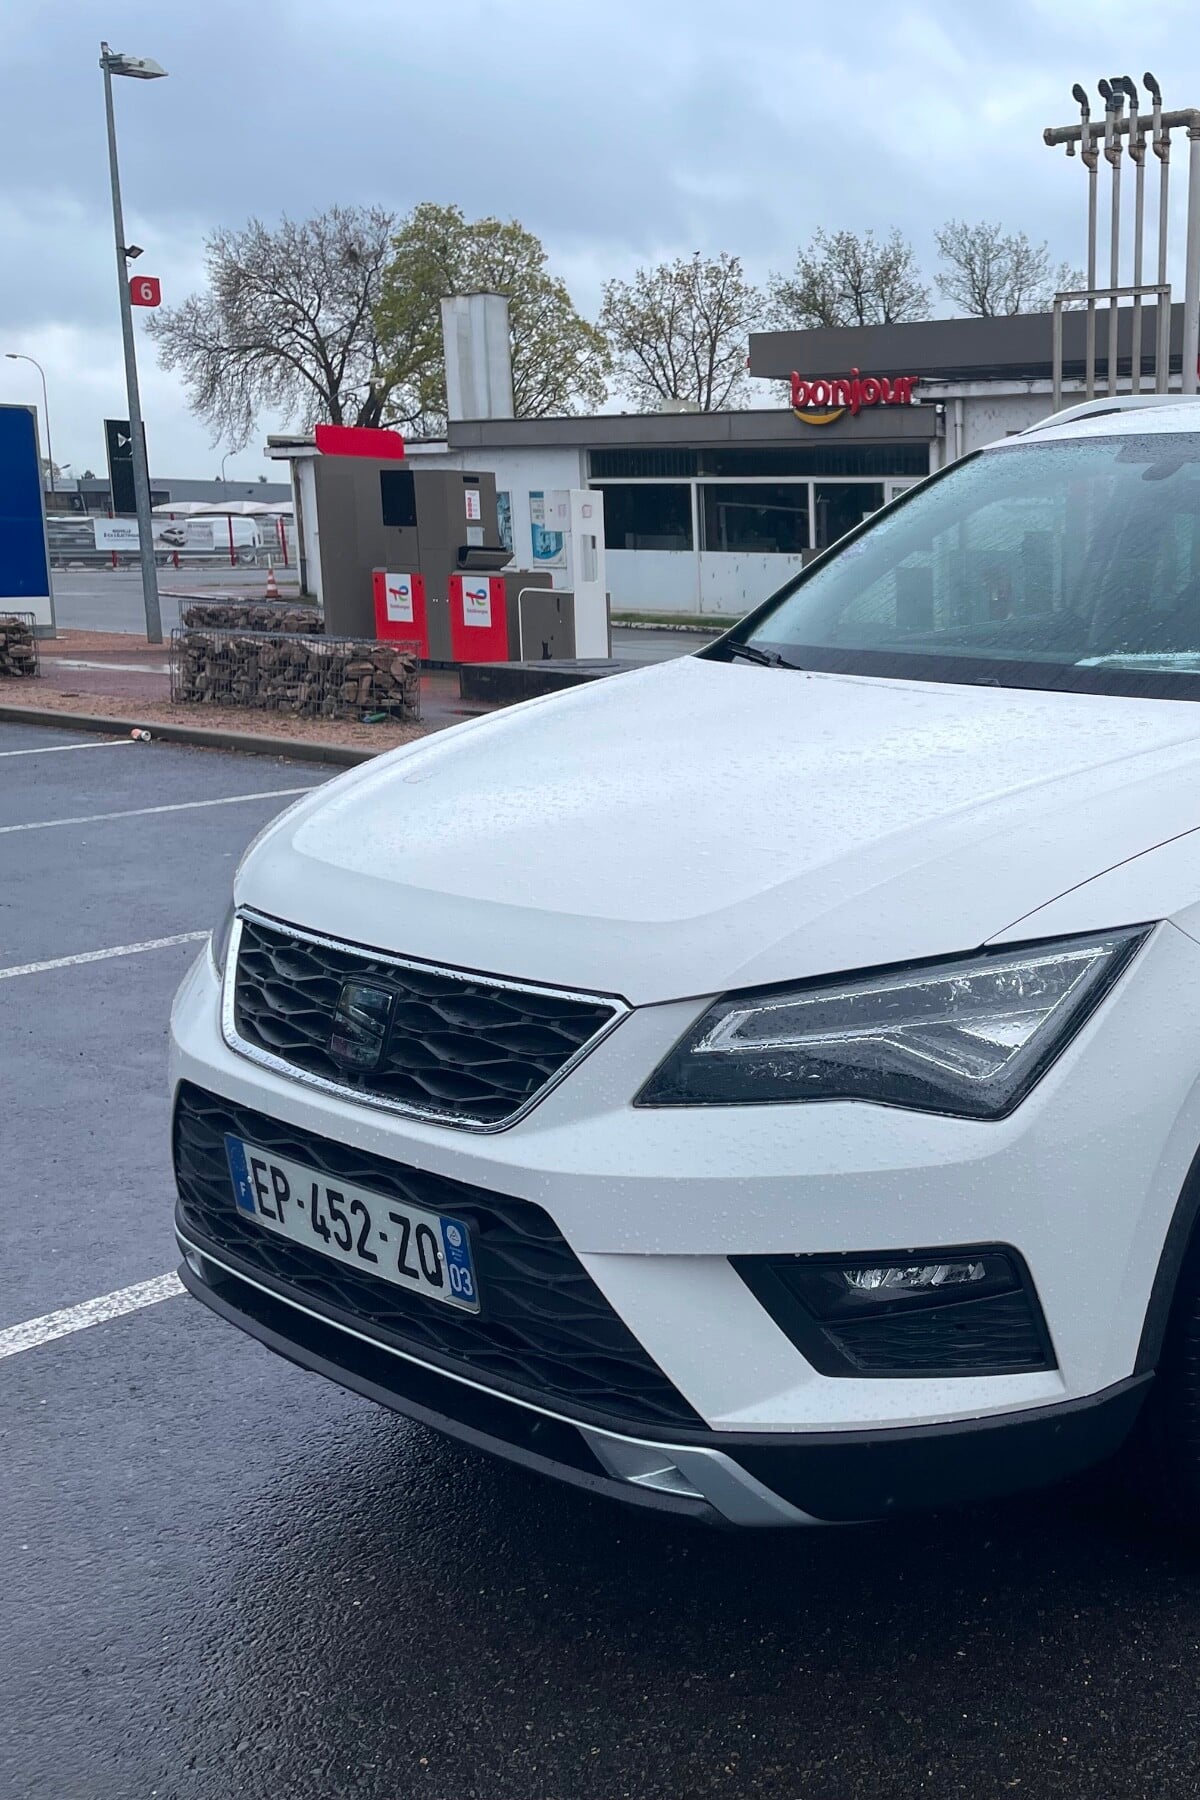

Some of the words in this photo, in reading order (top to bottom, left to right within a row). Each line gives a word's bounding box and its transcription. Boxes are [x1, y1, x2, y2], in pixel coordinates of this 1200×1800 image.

[140, 282, 153, 301] 6
[790, 367, 918, 416] bonjour
[239, 1181, 246, 1197] F
[250, 1156, 444, 1288] EP-452-ZQ
[449, 1263, 473, 1295] 03
